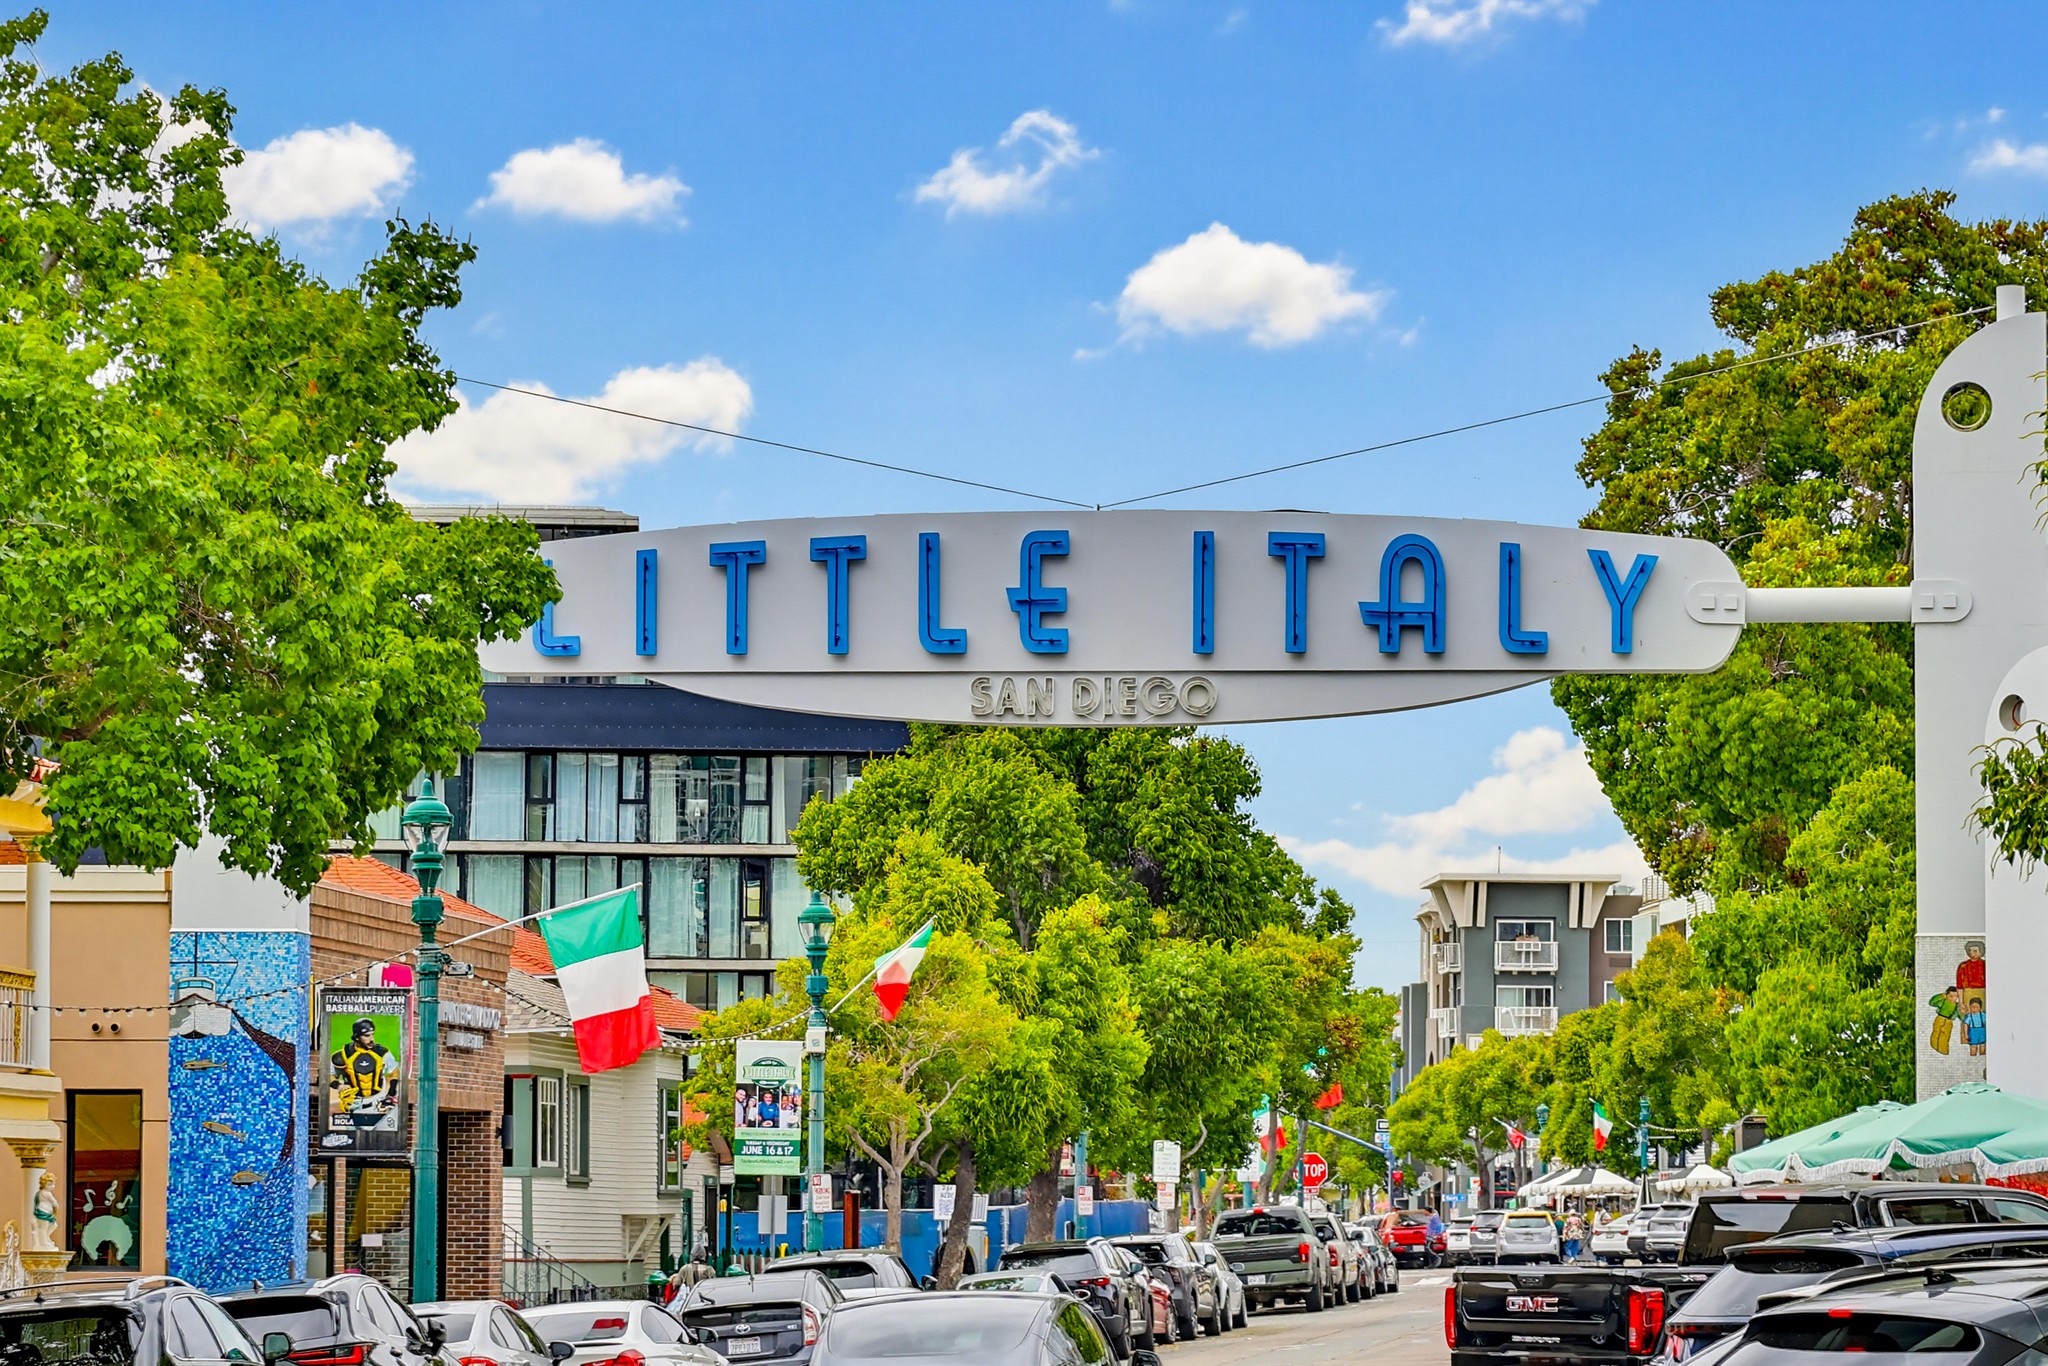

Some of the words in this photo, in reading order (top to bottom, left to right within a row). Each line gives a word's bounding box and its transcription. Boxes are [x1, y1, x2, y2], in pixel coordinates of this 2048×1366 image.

[532, 530, 1069, 656] LITTLE
[1193, 531, 1659, 655] ITALY
[970, 677, 1055, 716] SAN
[1071, 676, 1217, 718] DIEGO
[741, 1146, 763, 1155] JUNE
[766, 1146, 776, 1155] 16
[784, 1146, 794, 1155] 17
[1303, 1163, 1326, 1178] TOP
[1506, 1296, 1559, 1313] GMC
